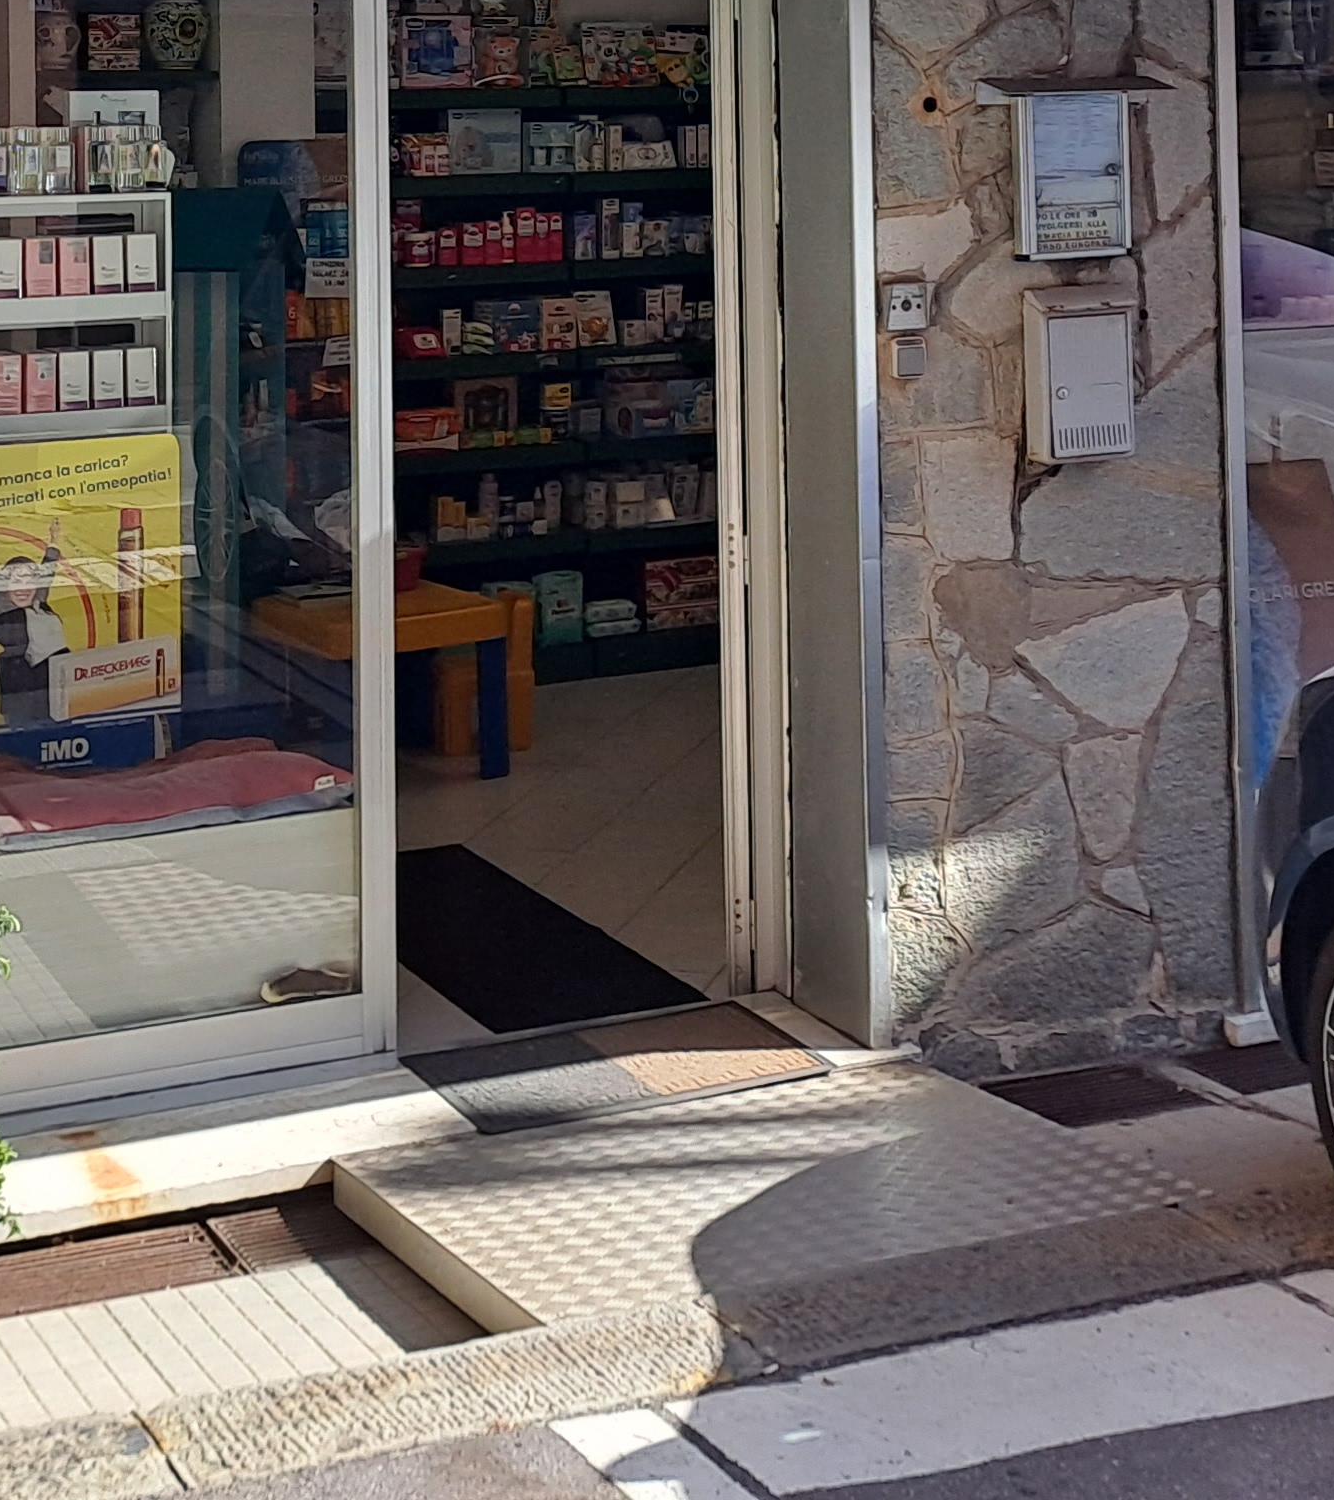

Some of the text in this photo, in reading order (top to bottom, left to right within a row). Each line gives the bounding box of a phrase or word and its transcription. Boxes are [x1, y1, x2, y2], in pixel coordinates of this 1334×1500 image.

[57, 465, 71, 478] la
[74, 454, 129, 474] carica?
[48, 486, 76, 500] con
[79, 467, 173, 495] l'omeopatia!
[1248, 584, 1300, 604] OLARI
